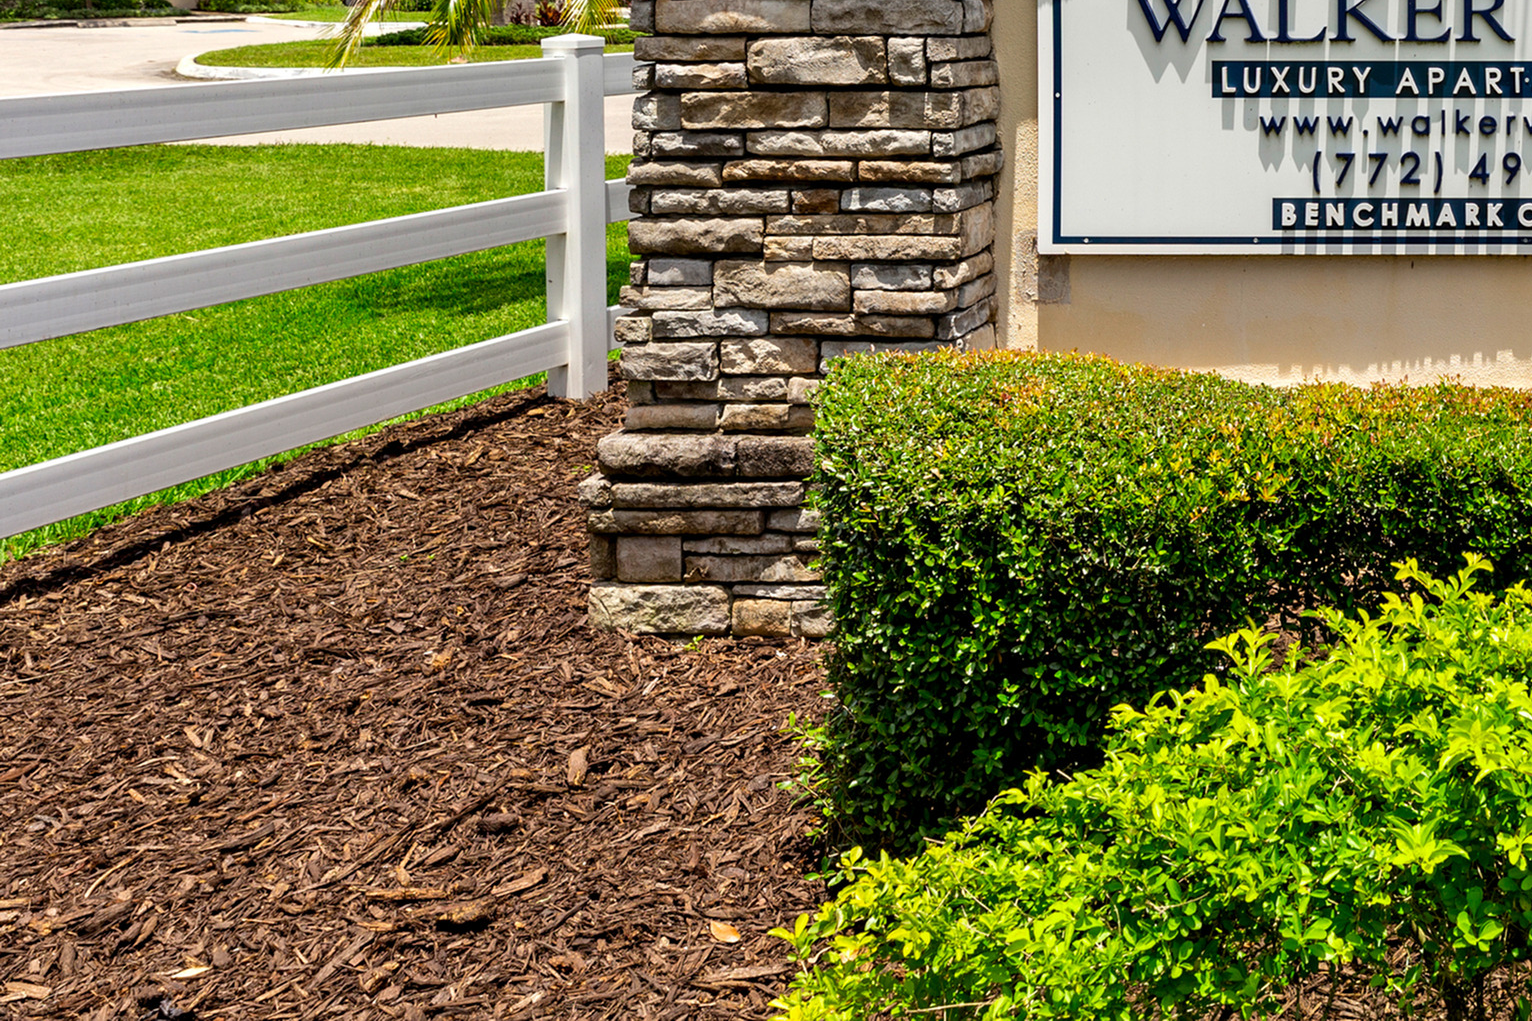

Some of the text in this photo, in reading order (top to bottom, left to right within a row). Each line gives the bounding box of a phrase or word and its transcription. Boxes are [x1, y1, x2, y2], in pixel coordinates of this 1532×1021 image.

[1221, 66, 1371, 94] LUXURY
[1312, 151, 1443, 193] (772)
[1282, 202, 1503, 227] BENCHMARK
